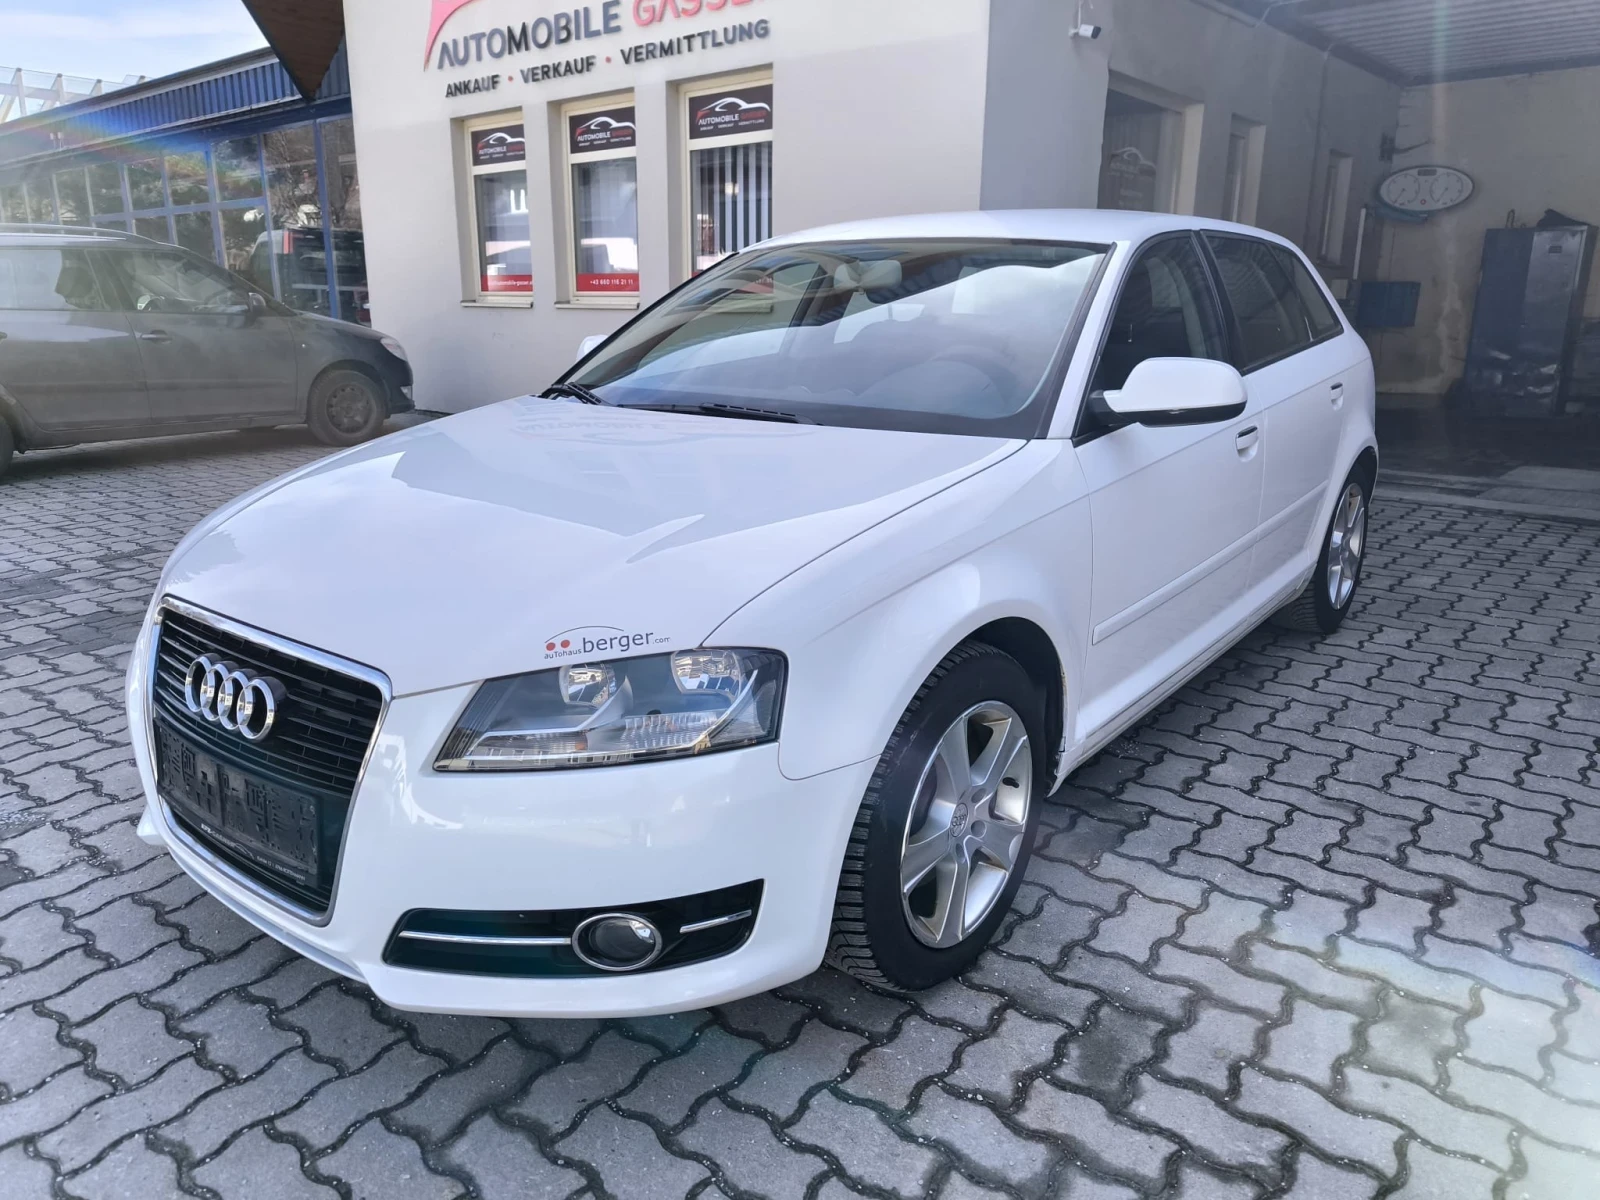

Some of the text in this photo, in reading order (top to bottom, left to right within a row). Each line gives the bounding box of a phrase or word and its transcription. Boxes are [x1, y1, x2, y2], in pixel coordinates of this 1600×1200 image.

[437, 0, 623, 70] AUTOMOBILE
[445, 19, 770, 98] ANKAUF VERKAUF VERMITTLUNG
[577, 131, 611, 142] AUTOMOBILE
[698, 113, 740, 126] AUTOMOBILE
